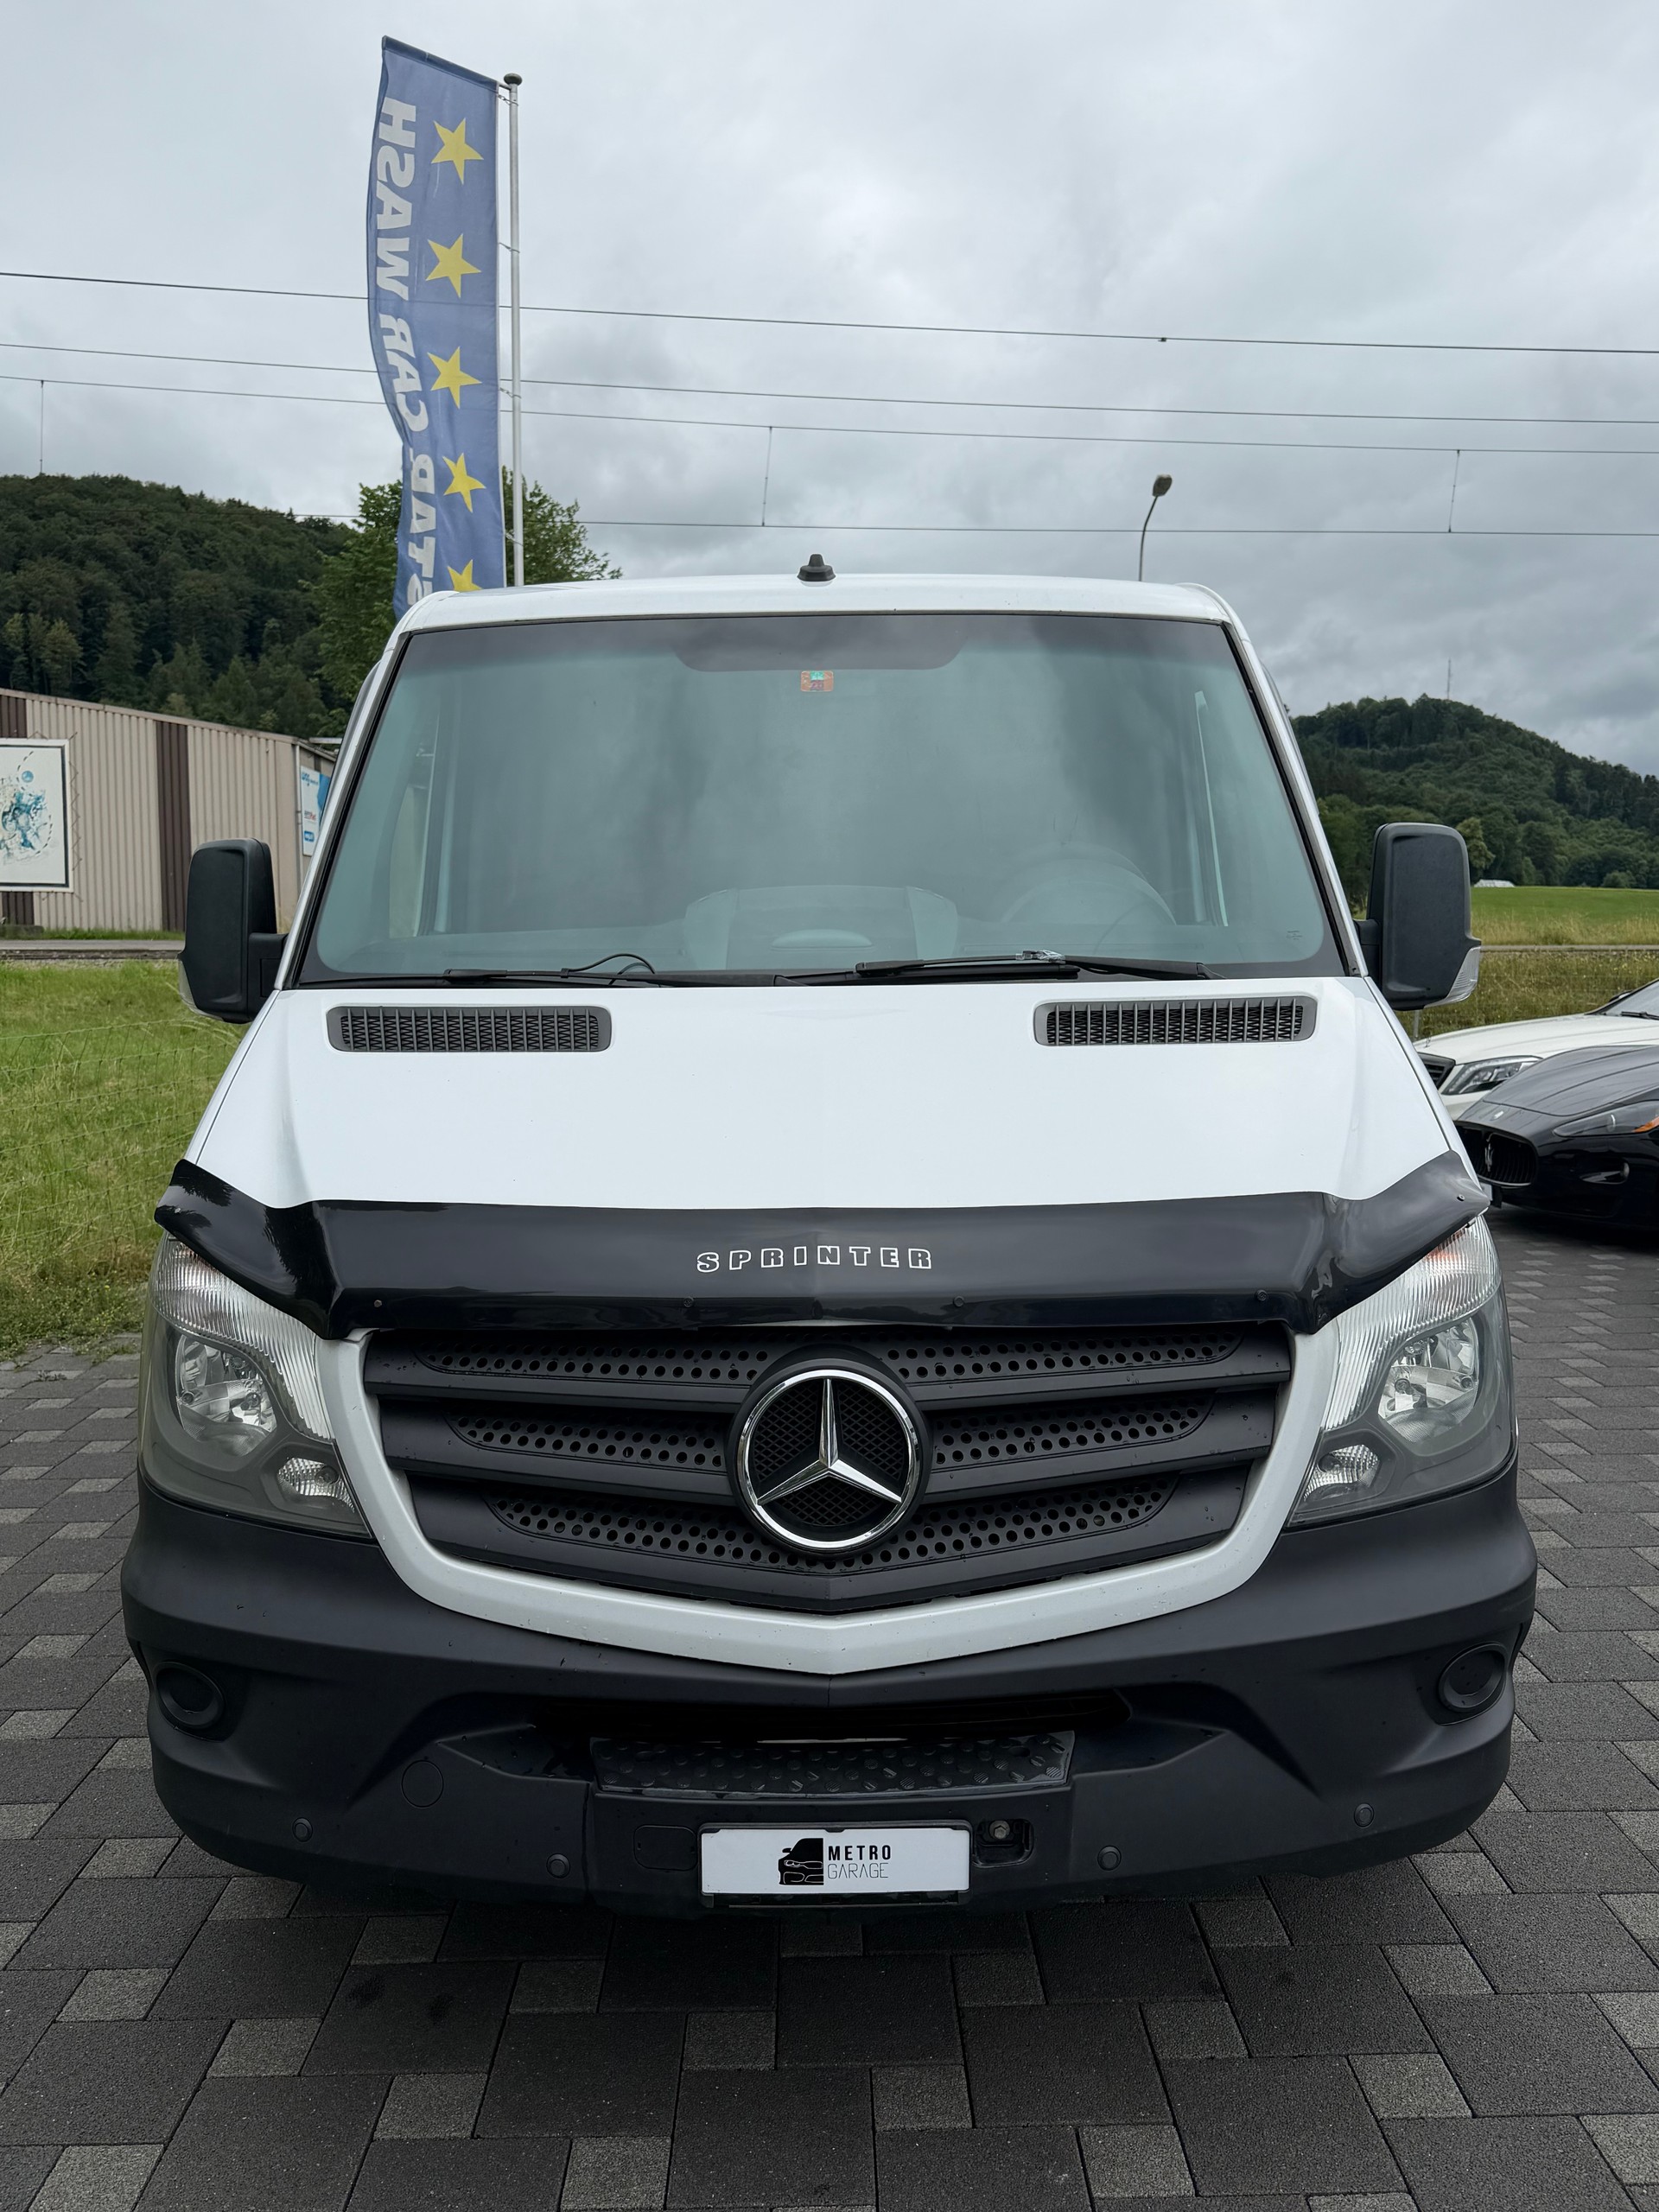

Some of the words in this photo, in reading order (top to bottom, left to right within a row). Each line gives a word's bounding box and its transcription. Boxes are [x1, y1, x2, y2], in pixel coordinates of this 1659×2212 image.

[696, 1245, 932, 1273] SPRINTER
[828, 1845, 892, 1861] METRO
[827, 1862, 889, 1879] GARAGE
